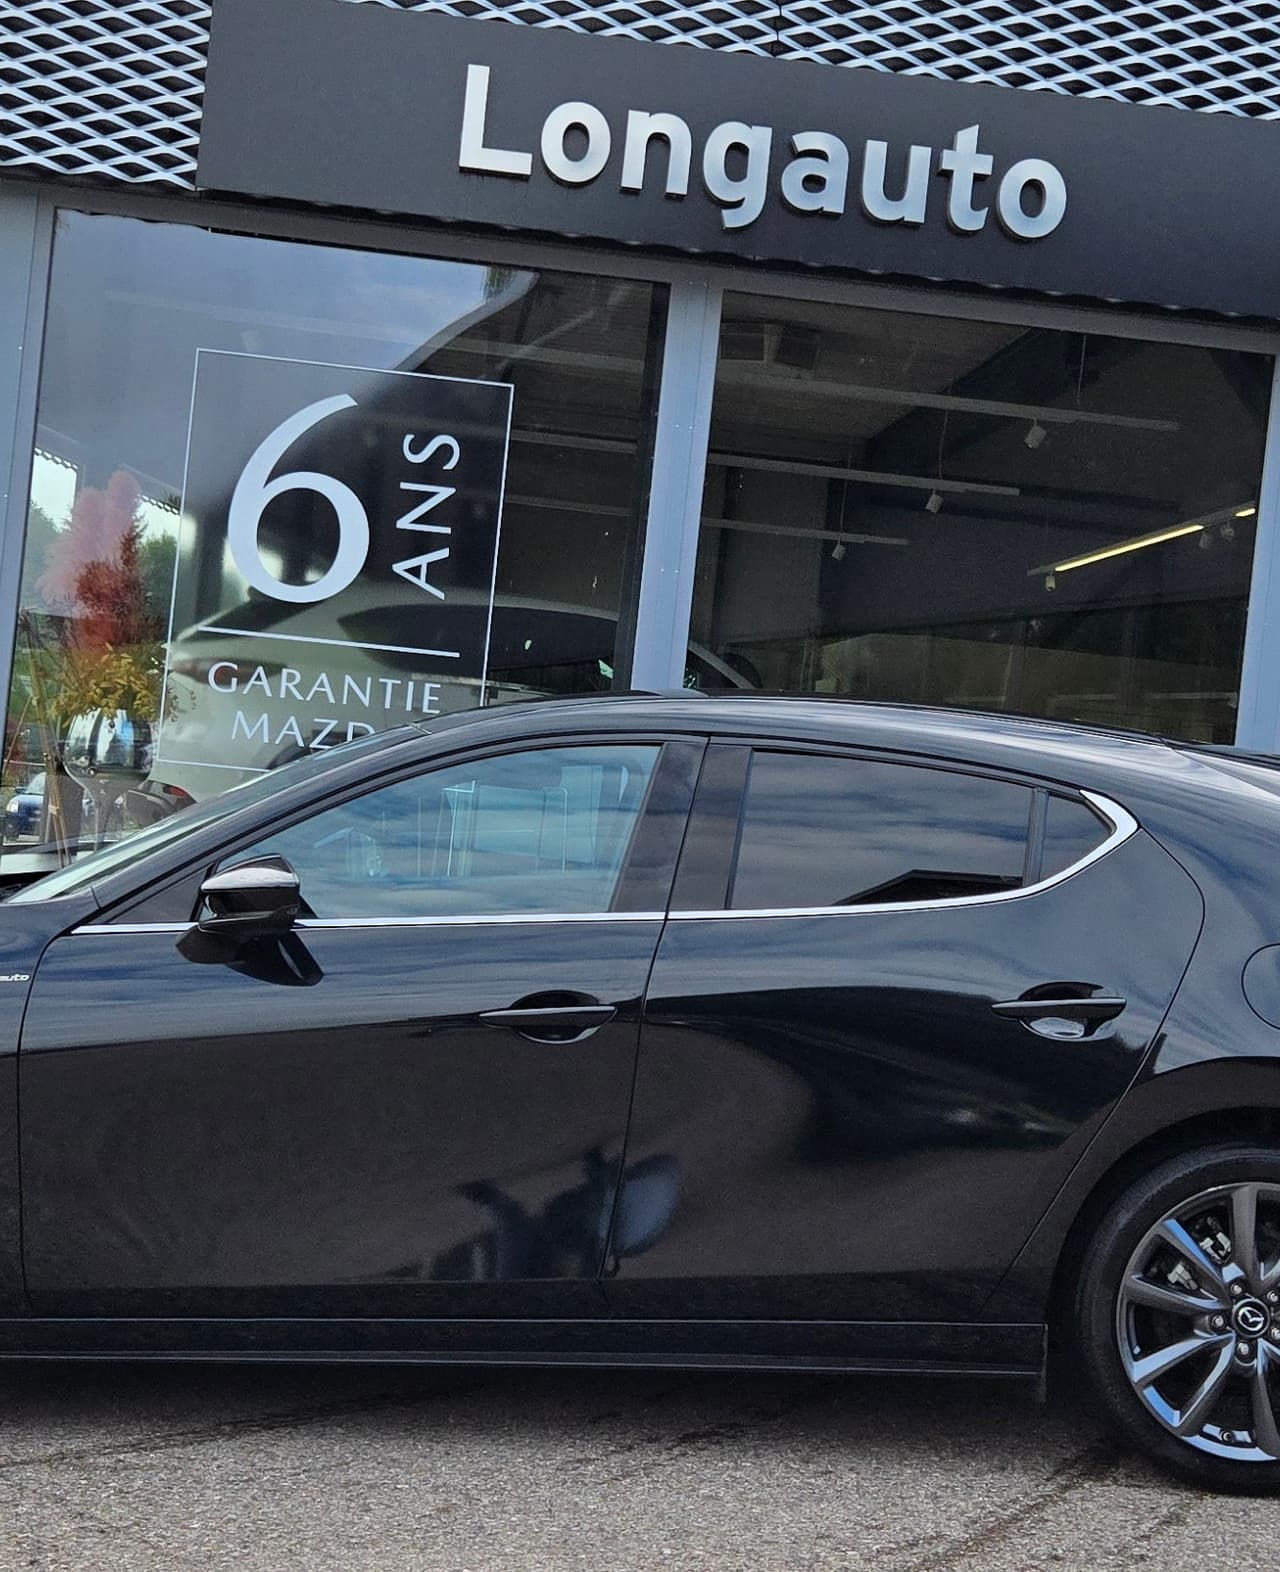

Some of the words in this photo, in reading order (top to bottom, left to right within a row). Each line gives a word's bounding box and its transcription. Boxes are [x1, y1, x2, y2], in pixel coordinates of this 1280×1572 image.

[459, 63, 1067, 239] Longauto
[227, 393, 370, 603] 6
[392, 433, 461, 600] ANS
[207, 661, 442, 715] GARANTIE
[231, 710, 378, 751] MAZD
